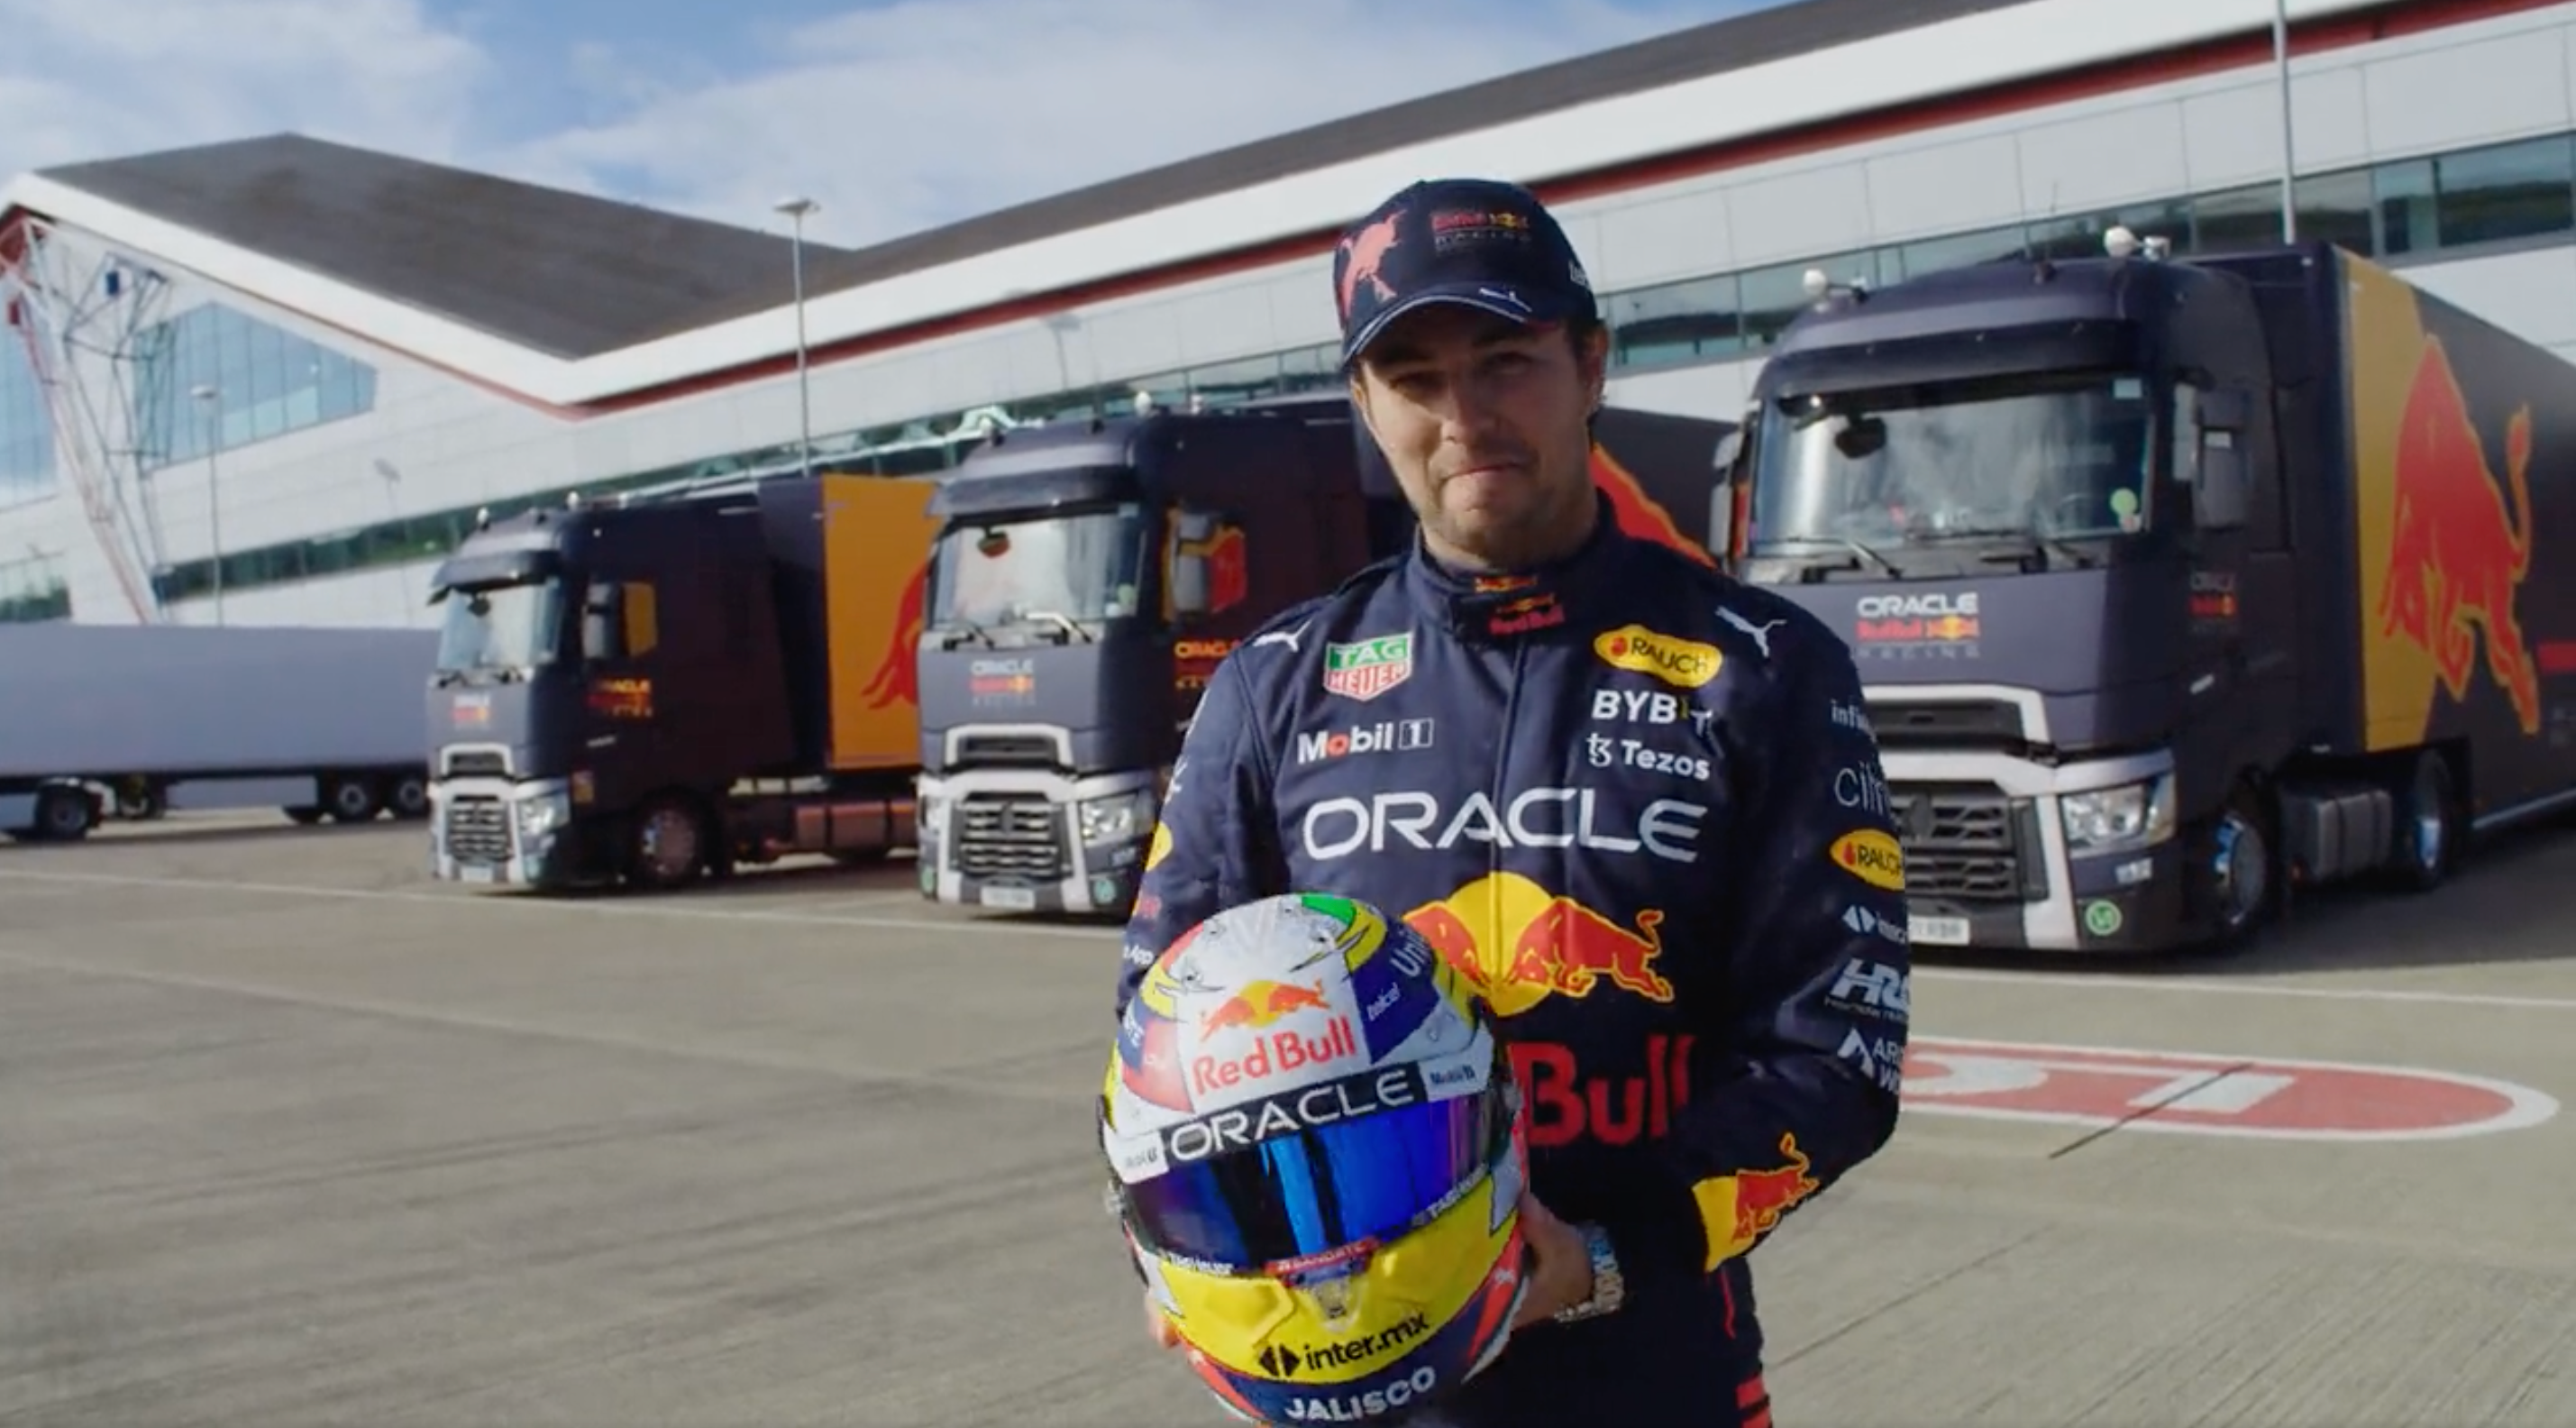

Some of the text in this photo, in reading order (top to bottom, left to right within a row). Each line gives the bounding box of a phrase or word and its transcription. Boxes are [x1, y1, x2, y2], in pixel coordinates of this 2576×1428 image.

[1857, 591, 1979, 618] ORACLE
[1329, 661, 1409, 697] HEUER
[1335, 638, 1406, 669] TAG
[1632, 636, 1709, 673] RAUCH
[1592, 689, 1713, 737] BYBIT
[1296, 722, 1393, 763] Mobil
[1621, 739, 1710, 781] Tezos
[1303, 787, 1708, 862] ORACLE
[1830, 958, 1909, 1014] HR
[1192, 1015, 1357, 1097] Red Bull
[1170, 1069, 1415, 1161] ORACLE
[1507, 1035, 1695, 1147] Bull
[1303, 1312, 1430, 1371] inter.mx
[1285, 1366, 1437, 1422] JALISCO
